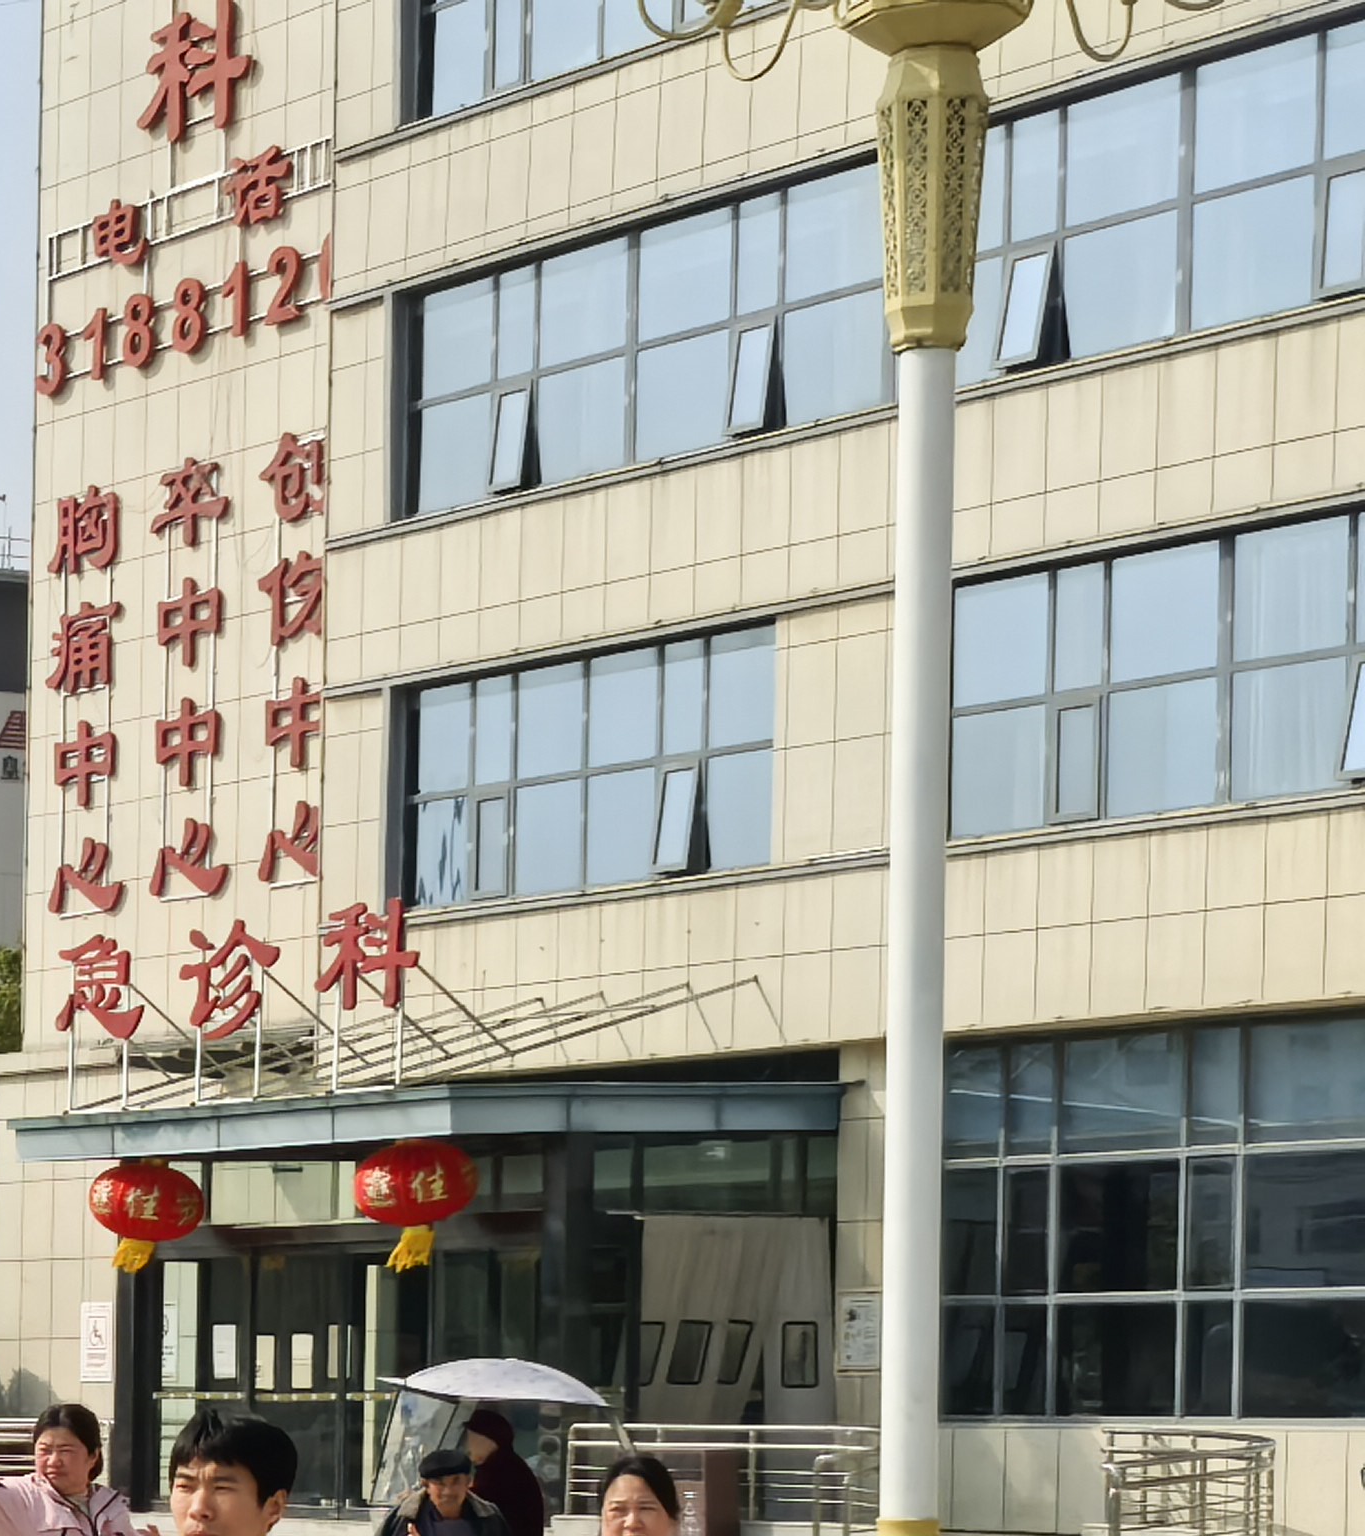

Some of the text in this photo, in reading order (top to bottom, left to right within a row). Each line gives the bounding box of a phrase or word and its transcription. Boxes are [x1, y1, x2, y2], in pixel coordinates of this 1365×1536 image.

[92, 145, 294, 265] 电话
[136, 0, 254, 142] 科
[45, 484, 123, 914] 胸痛中心
[149, 457, 229, 897] 卒中中心
[258, 432, 323, 882] 创伤中心
[55, 896, 420, 1040] 急诊科
